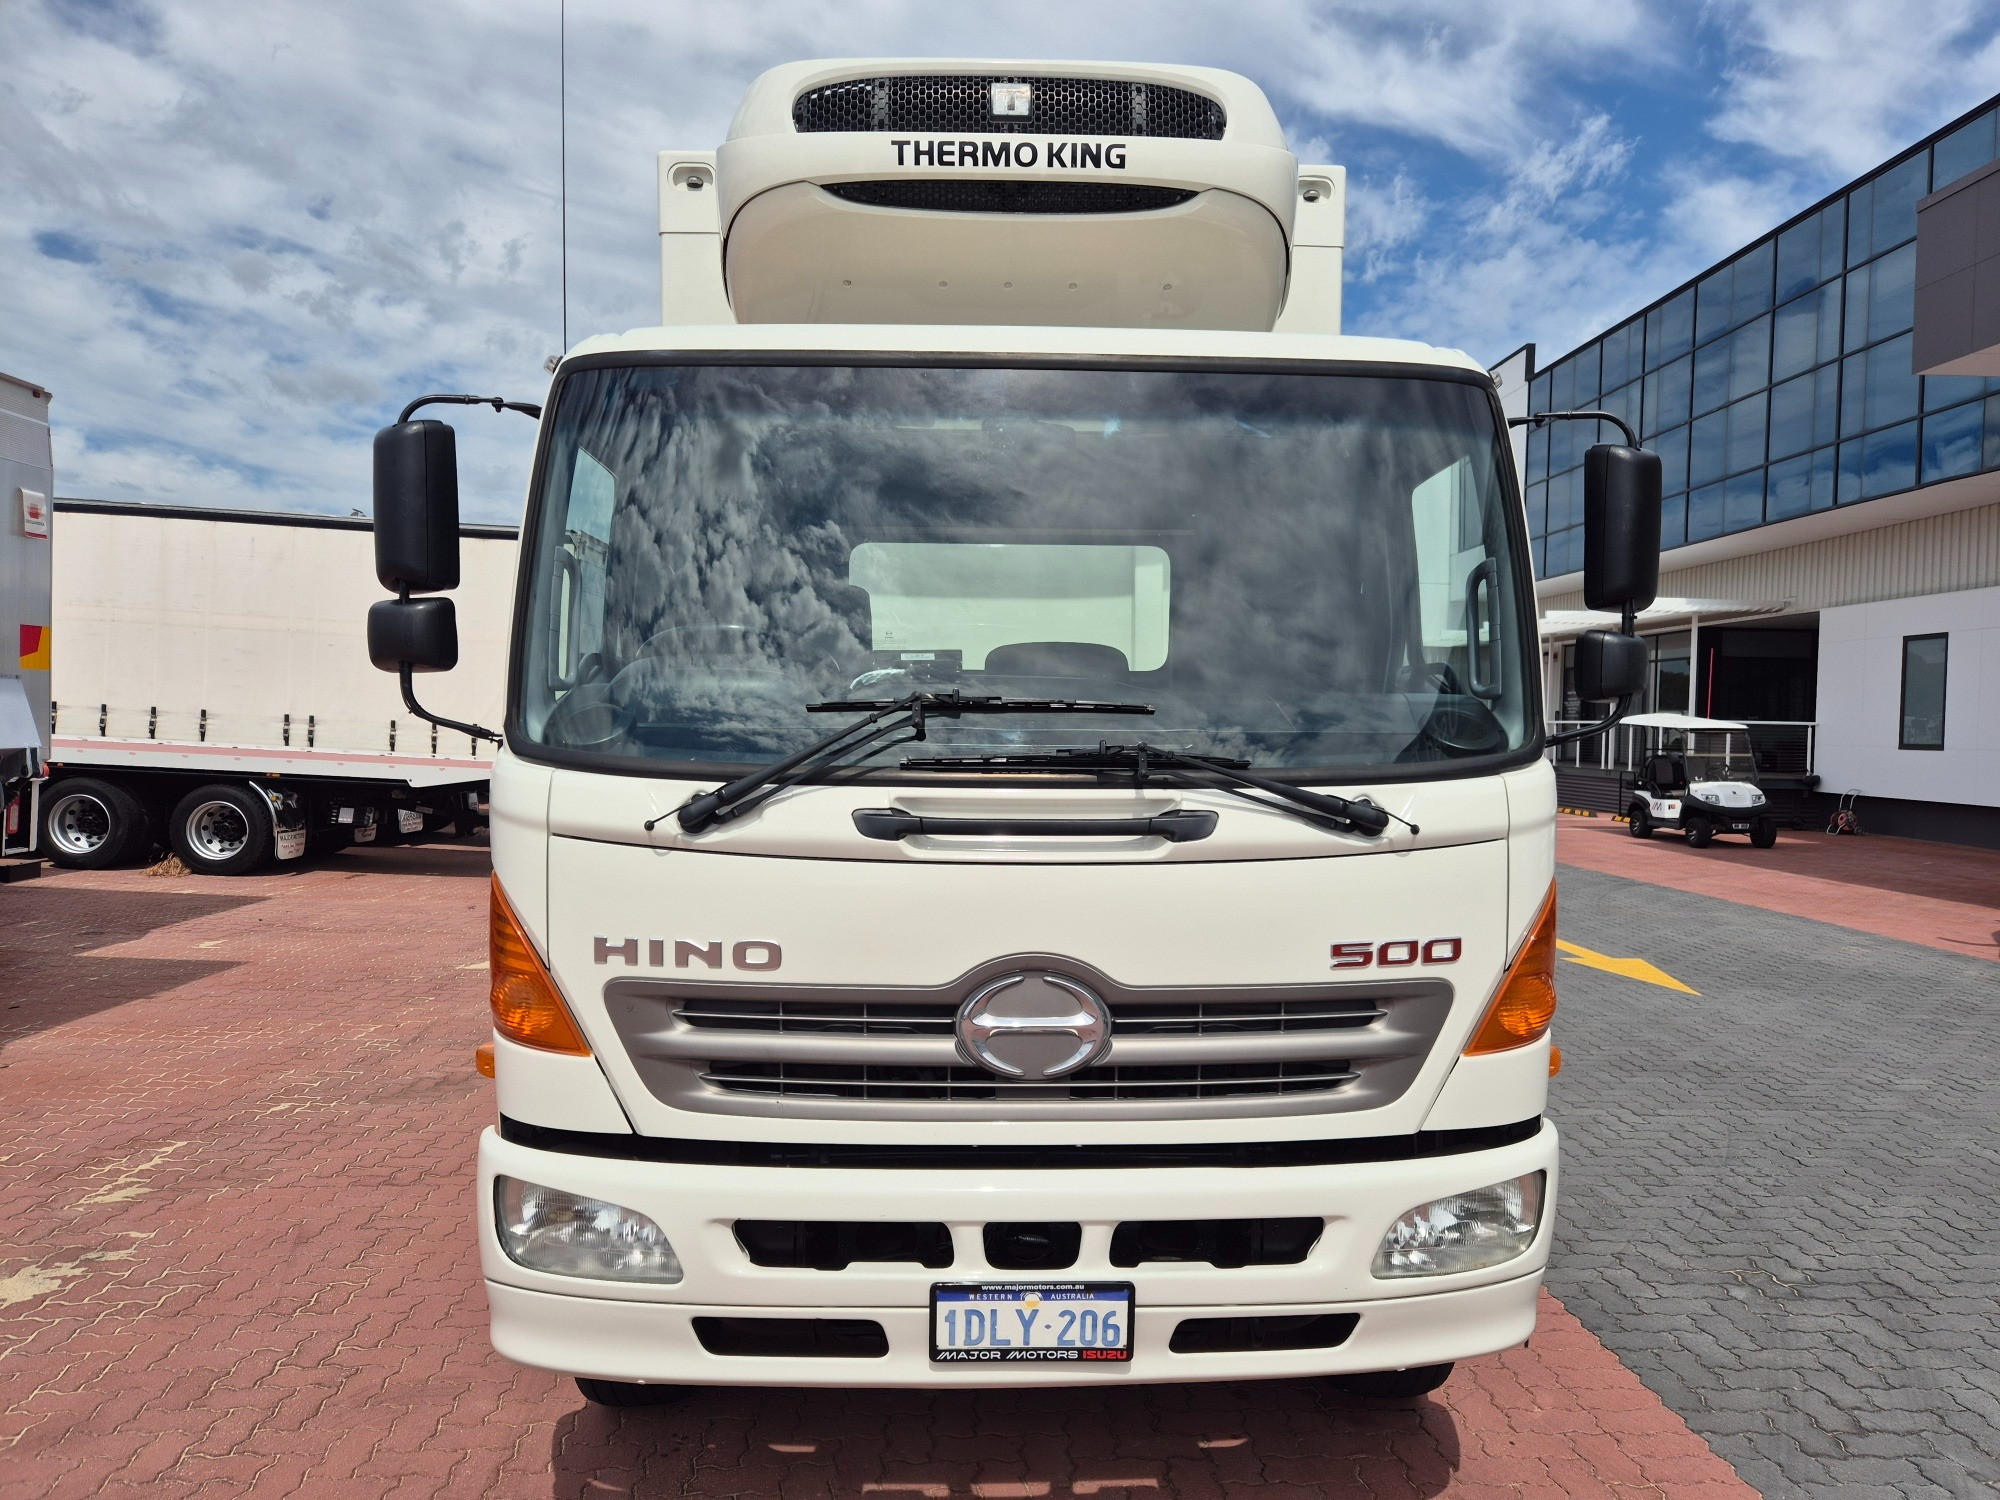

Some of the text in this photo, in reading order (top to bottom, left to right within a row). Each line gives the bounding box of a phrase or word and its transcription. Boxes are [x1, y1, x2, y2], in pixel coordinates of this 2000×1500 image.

[891, 140, 1126, 169] THERMO KING
[594, 935, 782, 971] HINO
[1330, 935, 1462, 971] 500
[981, 1284, 1085, 1292] www.majormotors.com.au
[936, 1350, 1127, 1360] MAJOR MOTORS ISUZU
